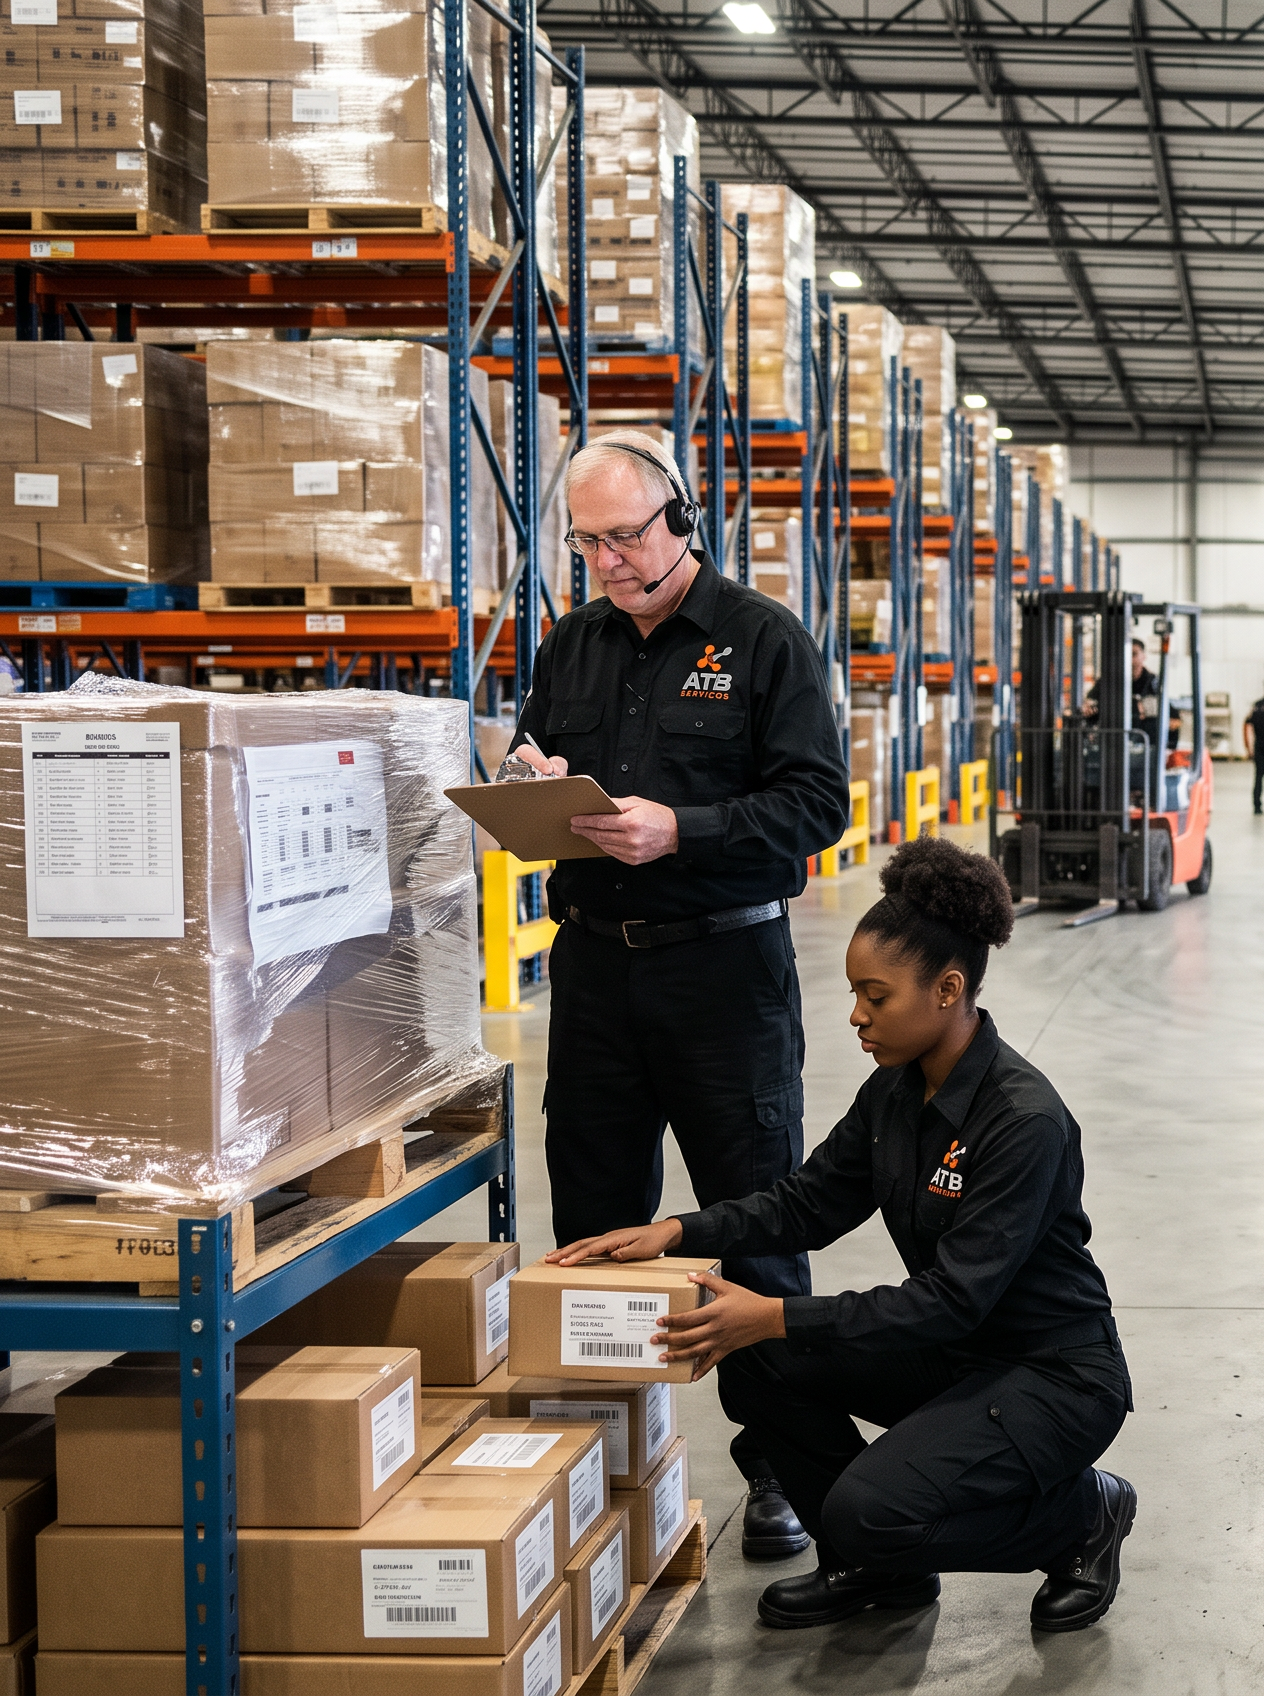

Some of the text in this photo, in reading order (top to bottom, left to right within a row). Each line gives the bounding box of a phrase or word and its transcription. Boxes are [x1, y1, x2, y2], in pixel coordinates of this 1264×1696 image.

[682, 671, 733, 692] ATB
[680, 690, 730, 700] SERVICOS
[930, 1167, 963, 1191] ATB
